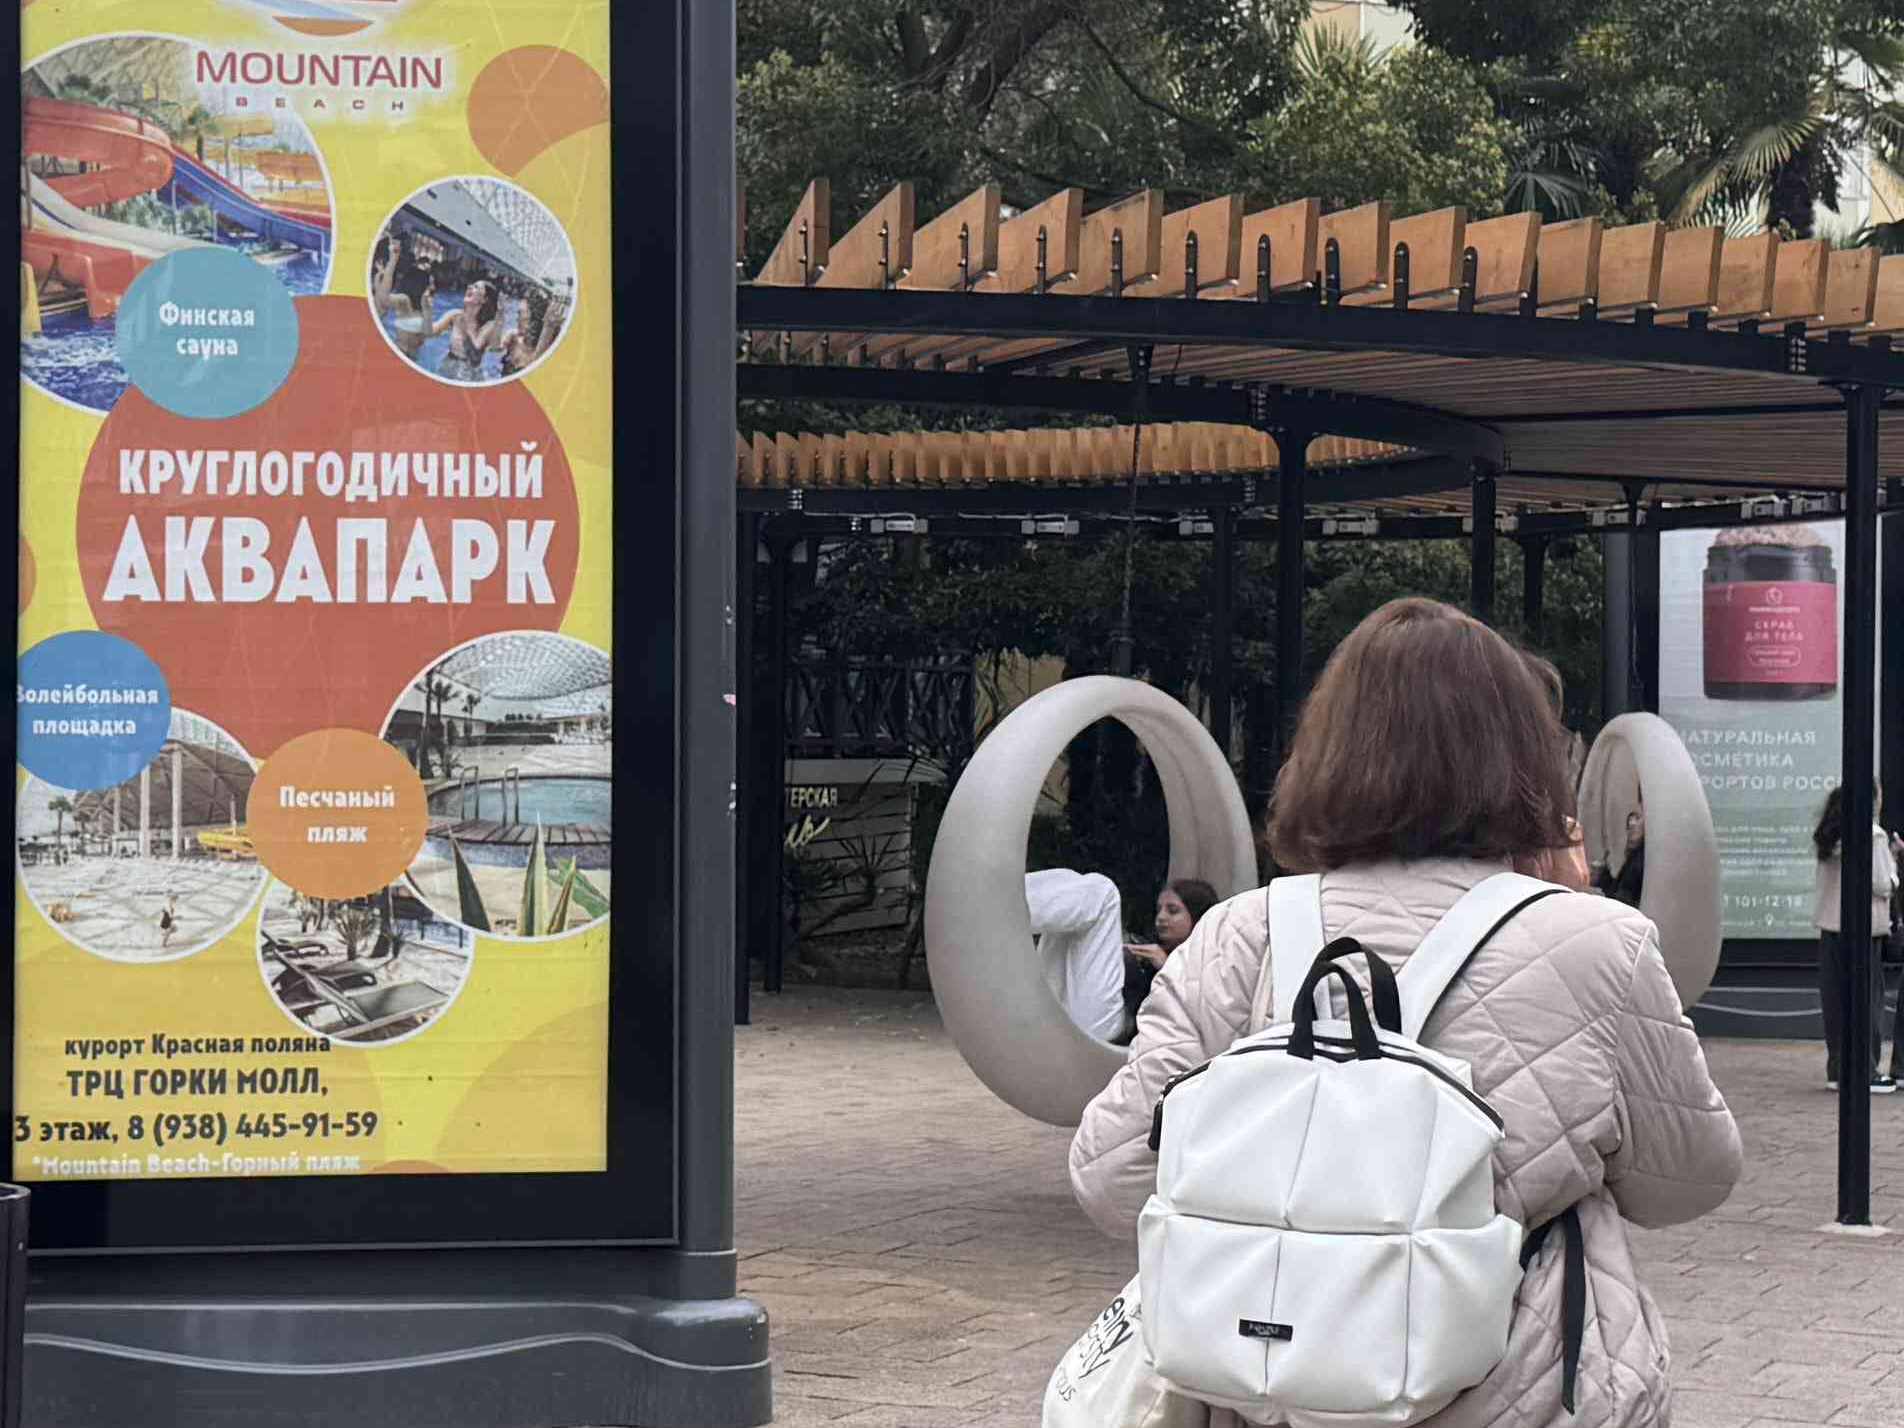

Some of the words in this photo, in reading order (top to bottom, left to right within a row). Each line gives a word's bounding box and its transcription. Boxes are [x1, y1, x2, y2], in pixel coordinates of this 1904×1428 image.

[197, 51, 442, 88] MOUNTAIN
[235, 96, 404, 110] BEACH
[159, 301, 255, 327] Финская
[176, 336, 239, 359] сауна
[119, 439, 544, 500] КРУГЛОГОДИЧНЫЙ
[101, 515, 557, 604] АКВАПАРК
[32, 719, 137, 736] площадка
[279, 783, 395, 809] Песчаный
[307, 822, 367, 845] пляж
[65, 1039, 145, 1060] курорт
[152, 1034, 244, 1058] Красная
[251, 1037, 331, 1054] поляна
[66, 1070, 124, 1099] ТРЦ
[133, 1069, 227, 1096] ГОРКИ
[237, 1067, 329, 1097] МОЛЛ,
[14, 1115, 31, 1142] 3
[39, 1119, 119, 1143] этаж,
[127, 1115, 145, 1141] 8
[153, 1113, 228, 1146] (938)
[235, 1111, 379, 1139] 445-91-59
[306, 1153, 361, 1172] пляж
